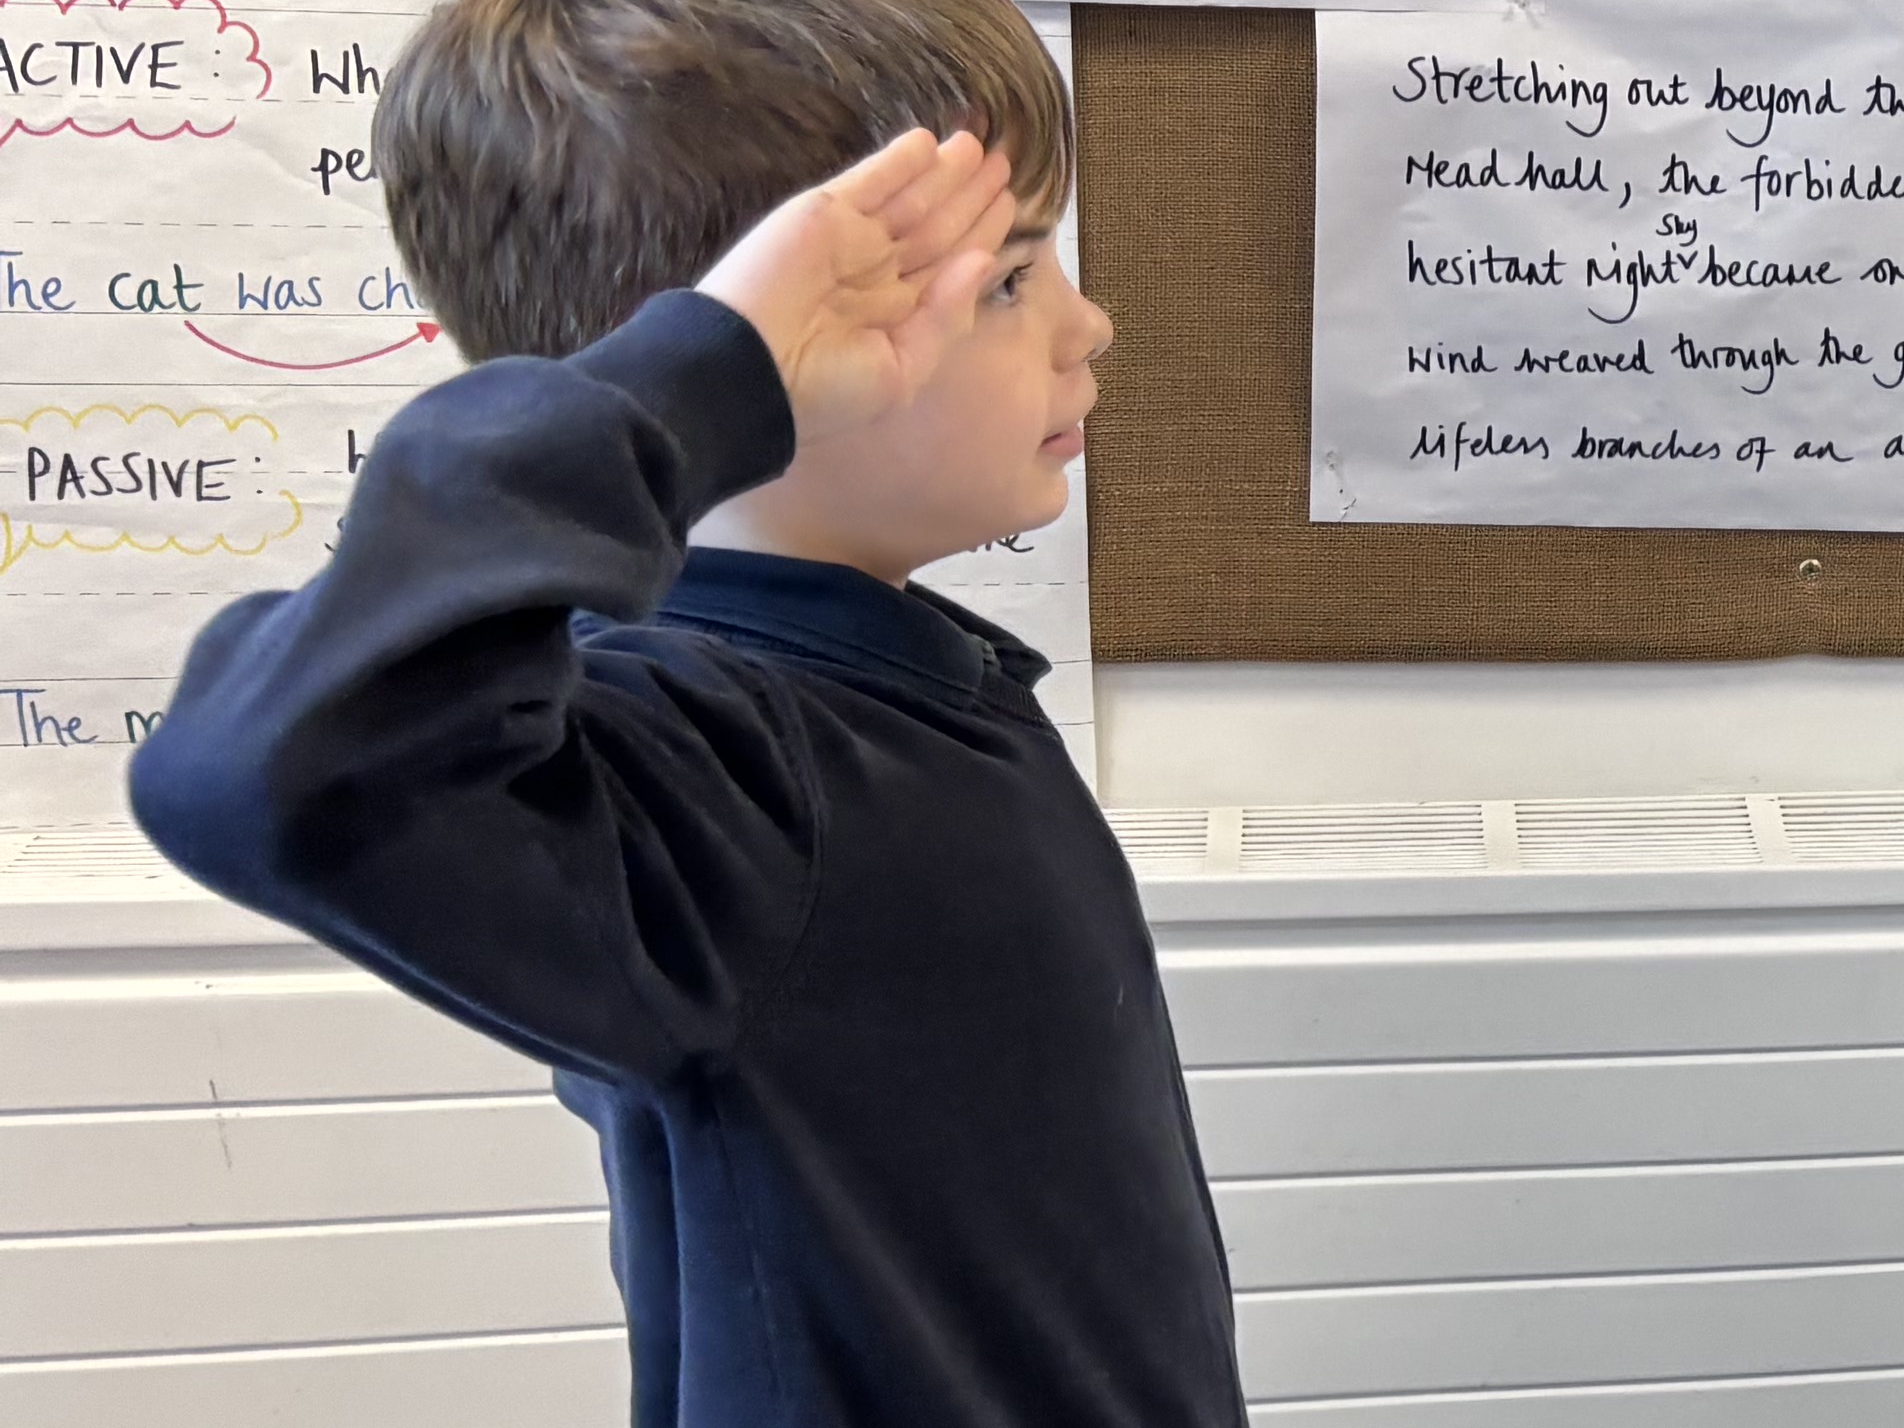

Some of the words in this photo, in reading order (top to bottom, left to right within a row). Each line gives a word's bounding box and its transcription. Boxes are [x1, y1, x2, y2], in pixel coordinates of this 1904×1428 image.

[1390, 54, 1609, 140] Stretching
[1626, 72, 1690, 108] out
[1703, 66, 1847, 149] beyond
[1514, 150, 1633, 210] hall,
[1657, 151, 1728, 197] the
[107, 262, 205, 315] cat
[1406, 238, 1566, 288] hesitant
[1669, 331, 1800, 397] through
[1816, 325, 1874, 368] the
[1570, 425, 1722, 461] branches
